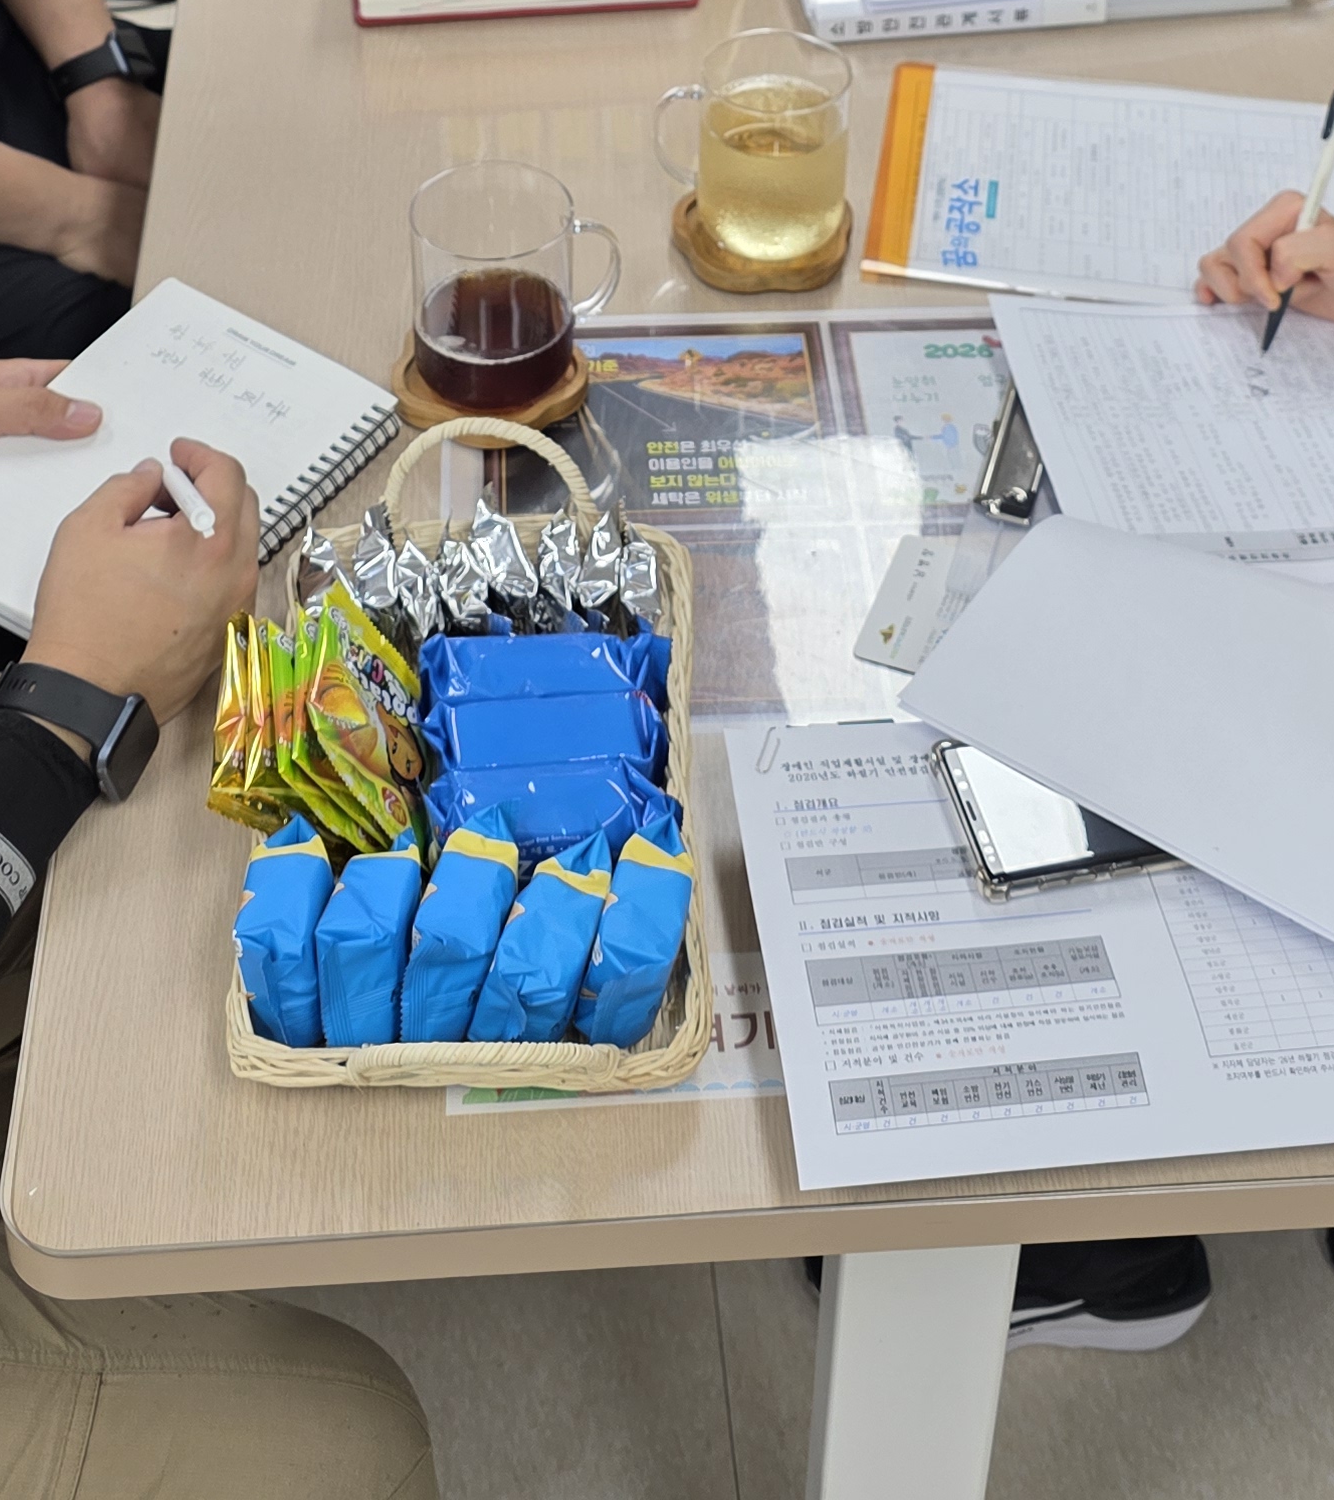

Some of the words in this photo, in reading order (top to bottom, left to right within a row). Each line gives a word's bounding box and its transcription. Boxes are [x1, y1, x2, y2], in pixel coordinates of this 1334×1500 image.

[923, 343, 994, 358] 2026
[646, 441, 695, 455] 안전은
[648, 457, 713, 471] 이용인을
[650, 476, 682, 488] 보지
[687, 475, 736, 488] 않는다
[652, 492, 700, 506] 세탁은
[847, 768, 878, 779] 하절기
[821, 916, 867, 929] 점검실적
[874, 914, 885, 925] 및
[893, 911, 939, 923] 지적사항
[1298, 1053, 1320, 1062] 하절기
[1264, 1068, 1286, 1078] 반드시
[1289, 1066, 1317, 1075] 확인하여
